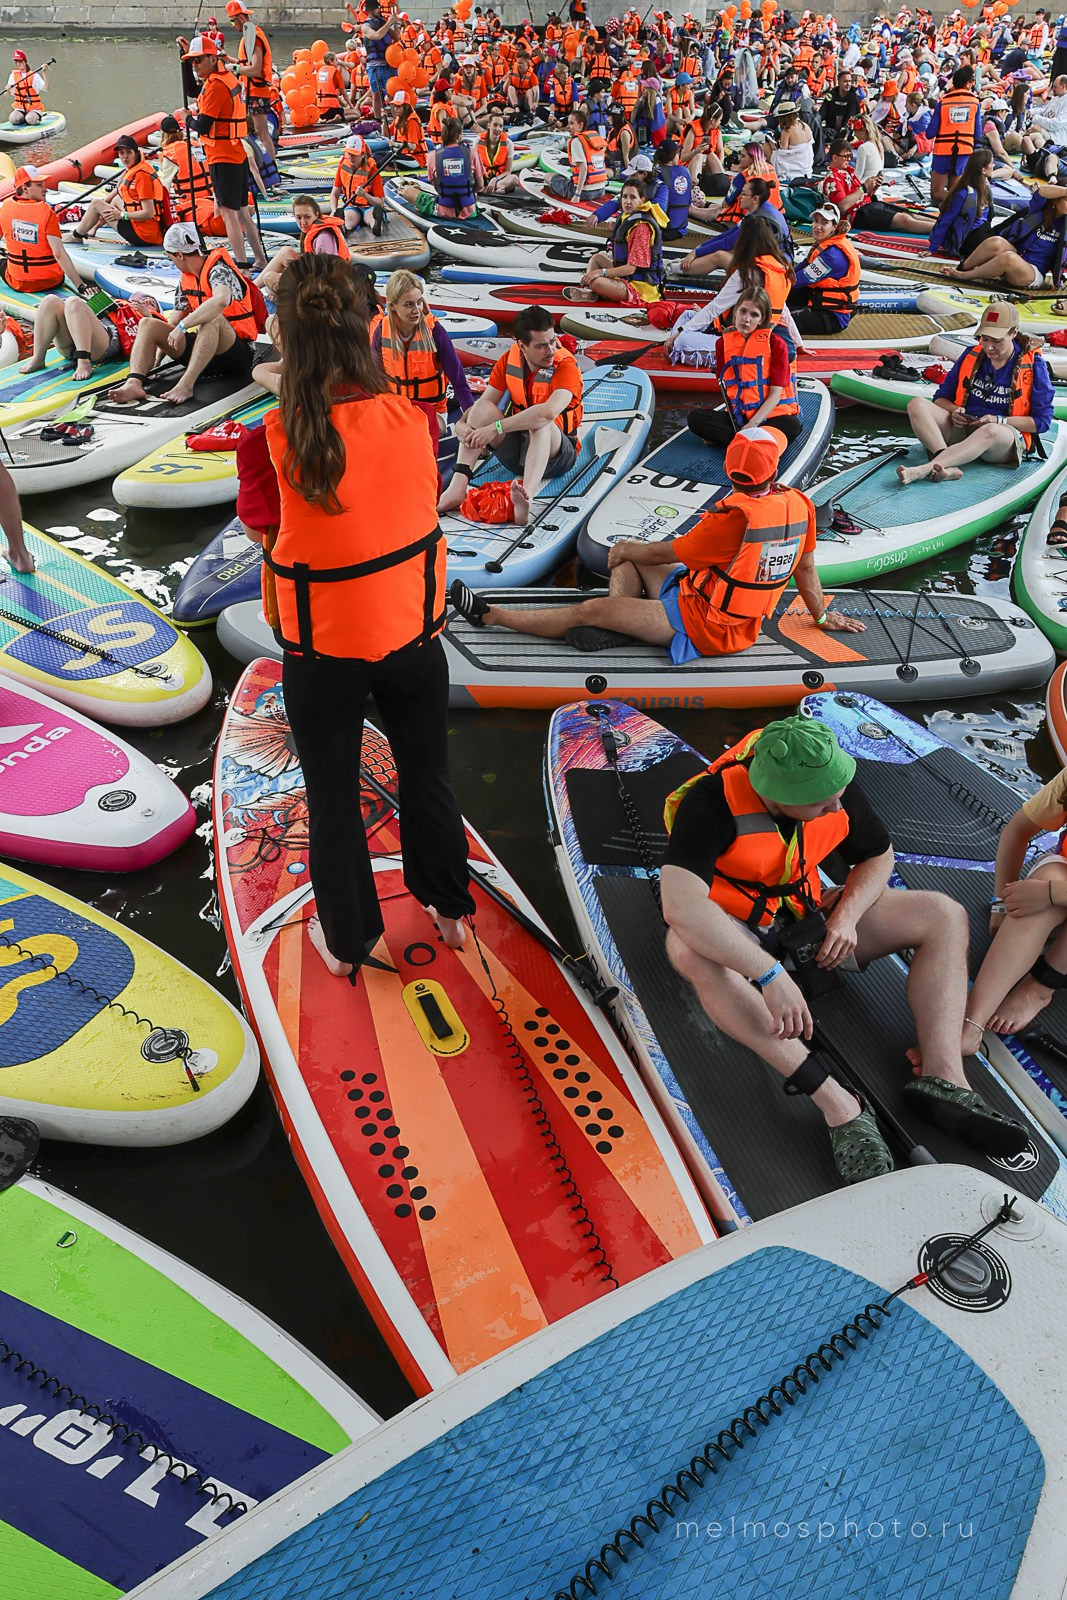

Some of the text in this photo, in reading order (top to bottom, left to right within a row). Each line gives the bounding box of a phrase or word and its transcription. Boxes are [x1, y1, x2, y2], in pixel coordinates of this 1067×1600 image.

[768, 553, 793, 567] 2928
[217, 562, 246, 581] PRO
[608, 696, 705, 709] OURUS
